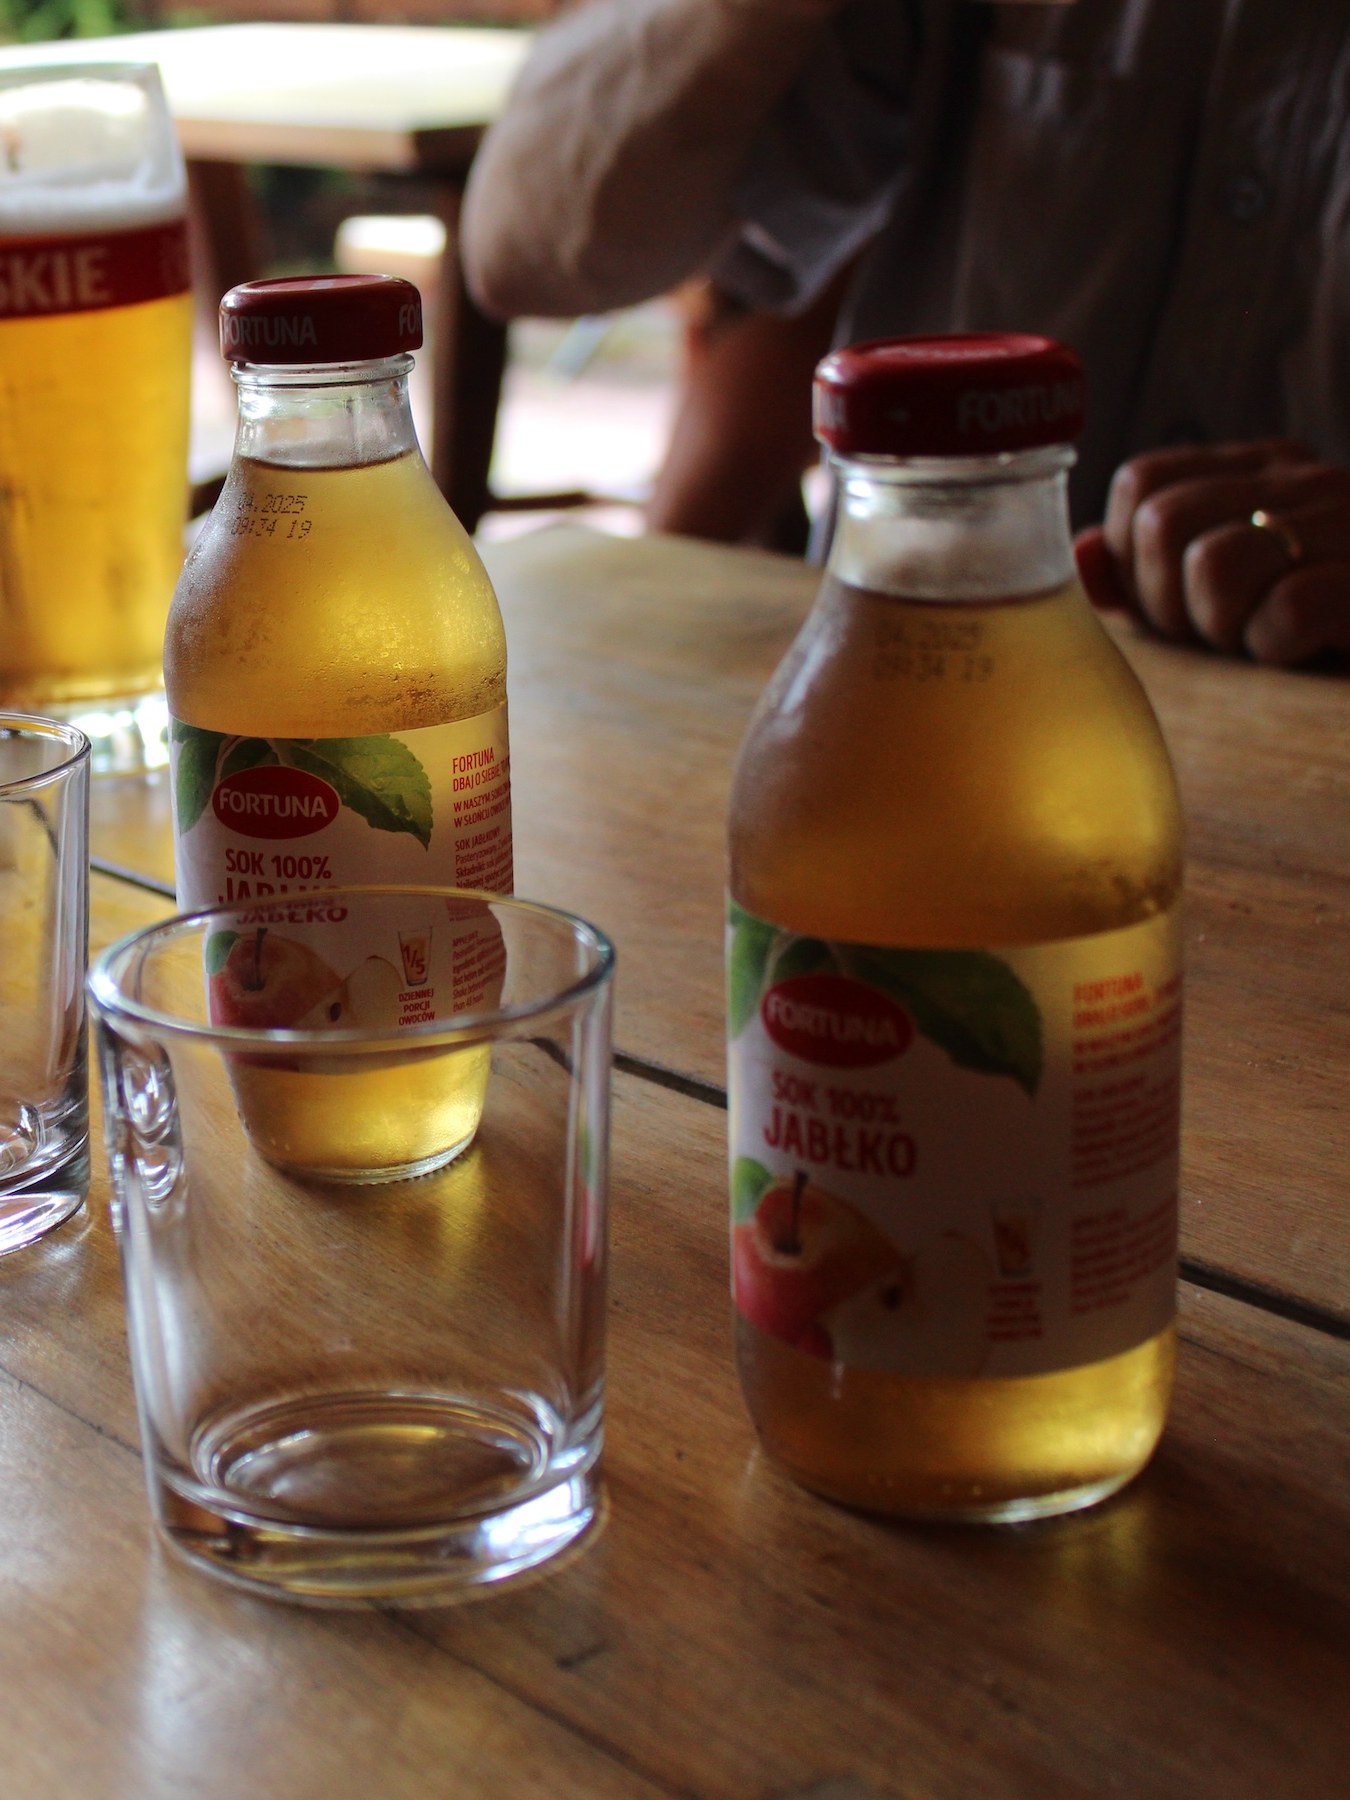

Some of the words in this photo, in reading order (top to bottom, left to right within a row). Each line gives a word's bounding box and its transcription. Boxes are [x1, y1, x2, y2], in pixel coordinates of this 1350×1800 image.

[222, 313, 317, 346] FORTUNA
[287, 519, 313, 539] 19
[452, 746, 495, 774] FORTUNA
[453, 775, 474, 792] DBAJ
[475, 772, 481, 786] O
[219, 787, 328, 818] FORTUNA
[453, 801, 463, 813] W
[463, 792, 492, 811] NASZYM
[454, 817, 463, 828] W
[455, 838, 471, 852] SOK
[226, 848, 265, 877] SOK
[271, 854, 332, 881] 100%
[398, 988, 434, 1002] DZIENNEJ
[403, 1000, 430, 1013] PORCJI
[398, 1011, 435, 1026] OWOCÓW
[765, 989, 899, 1046] FORTUNA
[771, 1069, 818, 1109] SOK
[826, 1086, 900, 1123] 100%
[762, 1105, 918, 1178] JABŁKO
